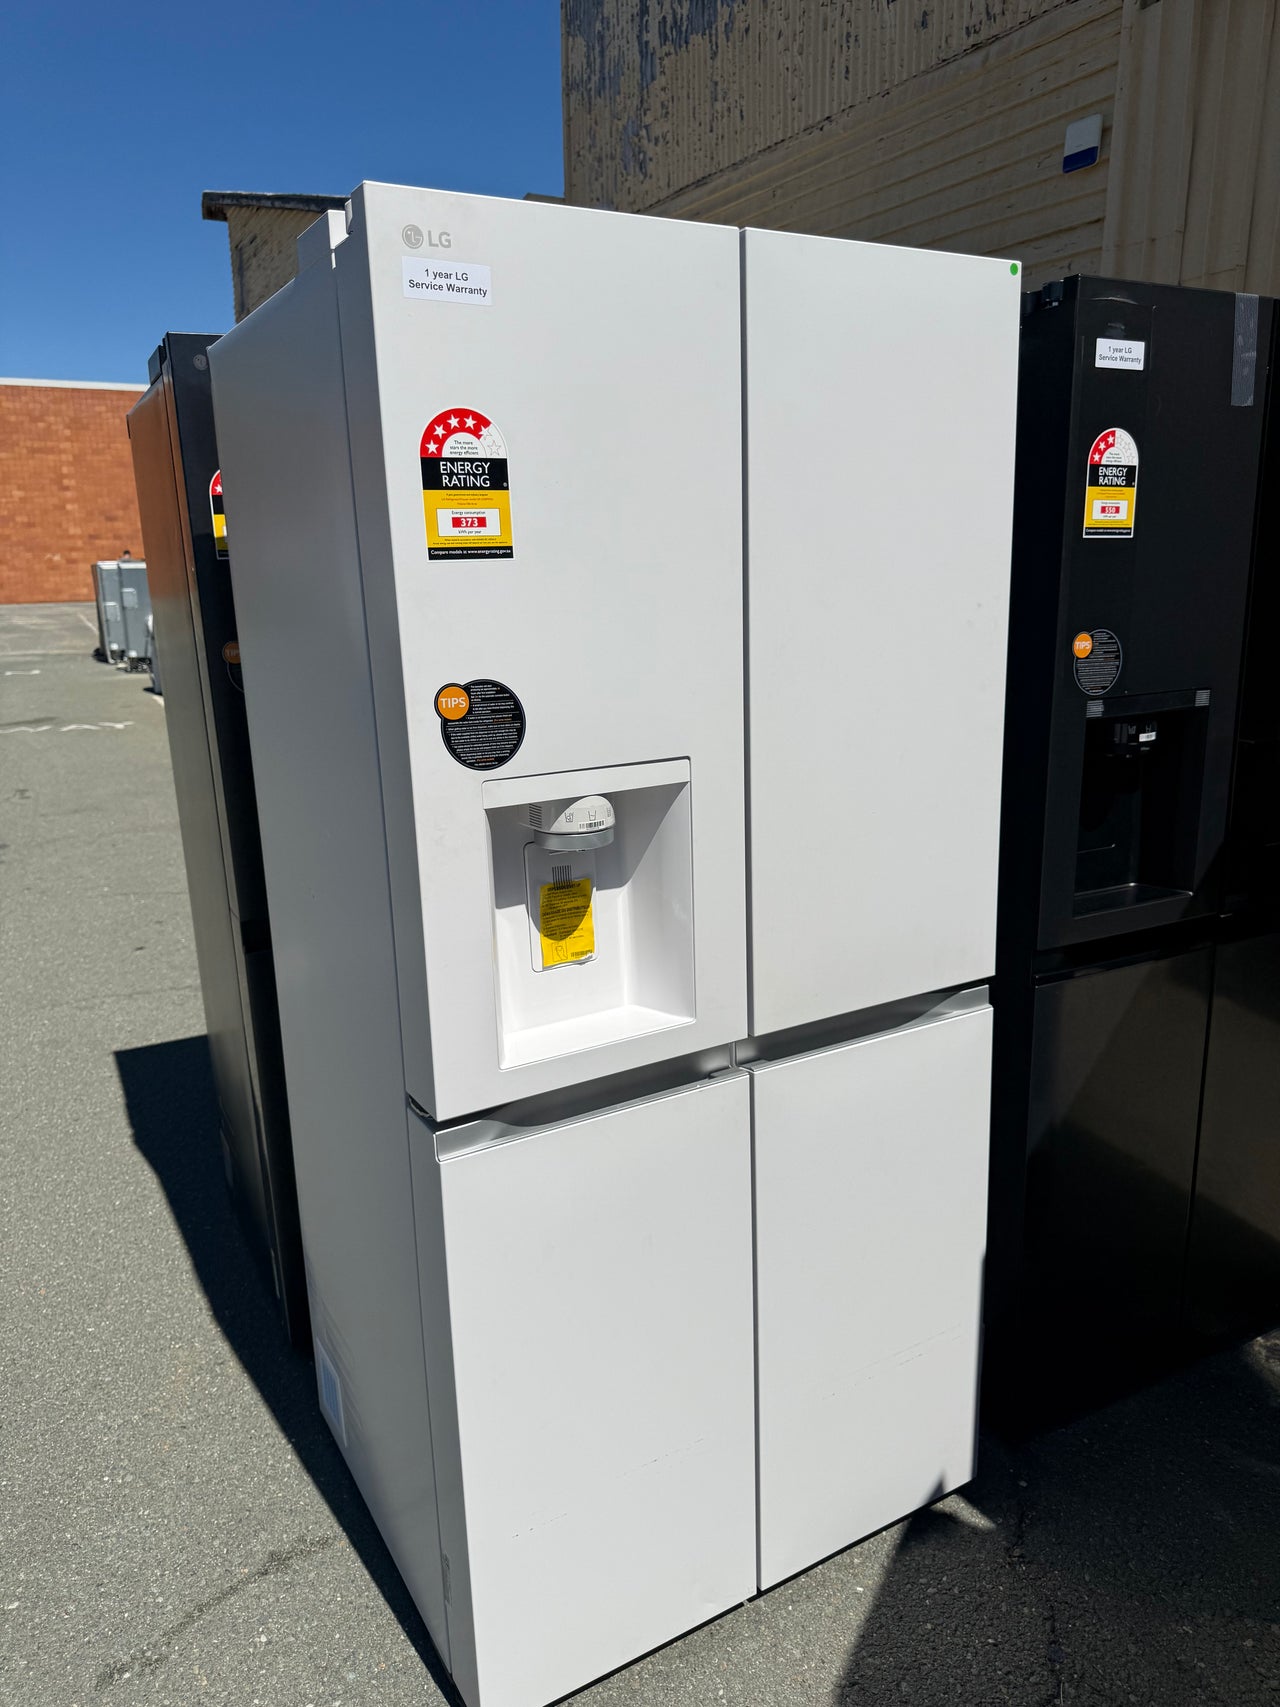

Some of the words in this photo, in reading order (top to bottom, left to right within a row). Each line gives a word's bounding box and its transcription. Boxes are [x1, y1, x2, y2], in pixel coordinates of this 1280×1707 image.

[428, 229, 452, 248] LG
[425, 268, 429, 277] 1
[433, 270, 453, 280] year
[455, 271, 469, 281] LG
[408, 279, 444, 291] Service
[446, 283, 488, 297] Warranty
[1098, 353, 1118, 362] Service
[1119, 355, 1141, 364] Warranty
[440, 461, 490, 474] ENERGY
[1098, 466, 1128, 477] ENERGY
[442, 474, 490, 487] RATING
[1098, 476, 1126, 486] RATING
[460, 518, 478, 527] 373
[1075, 641, 1091, 650] TIPS
[440, 697, 466, 709] TIPS
